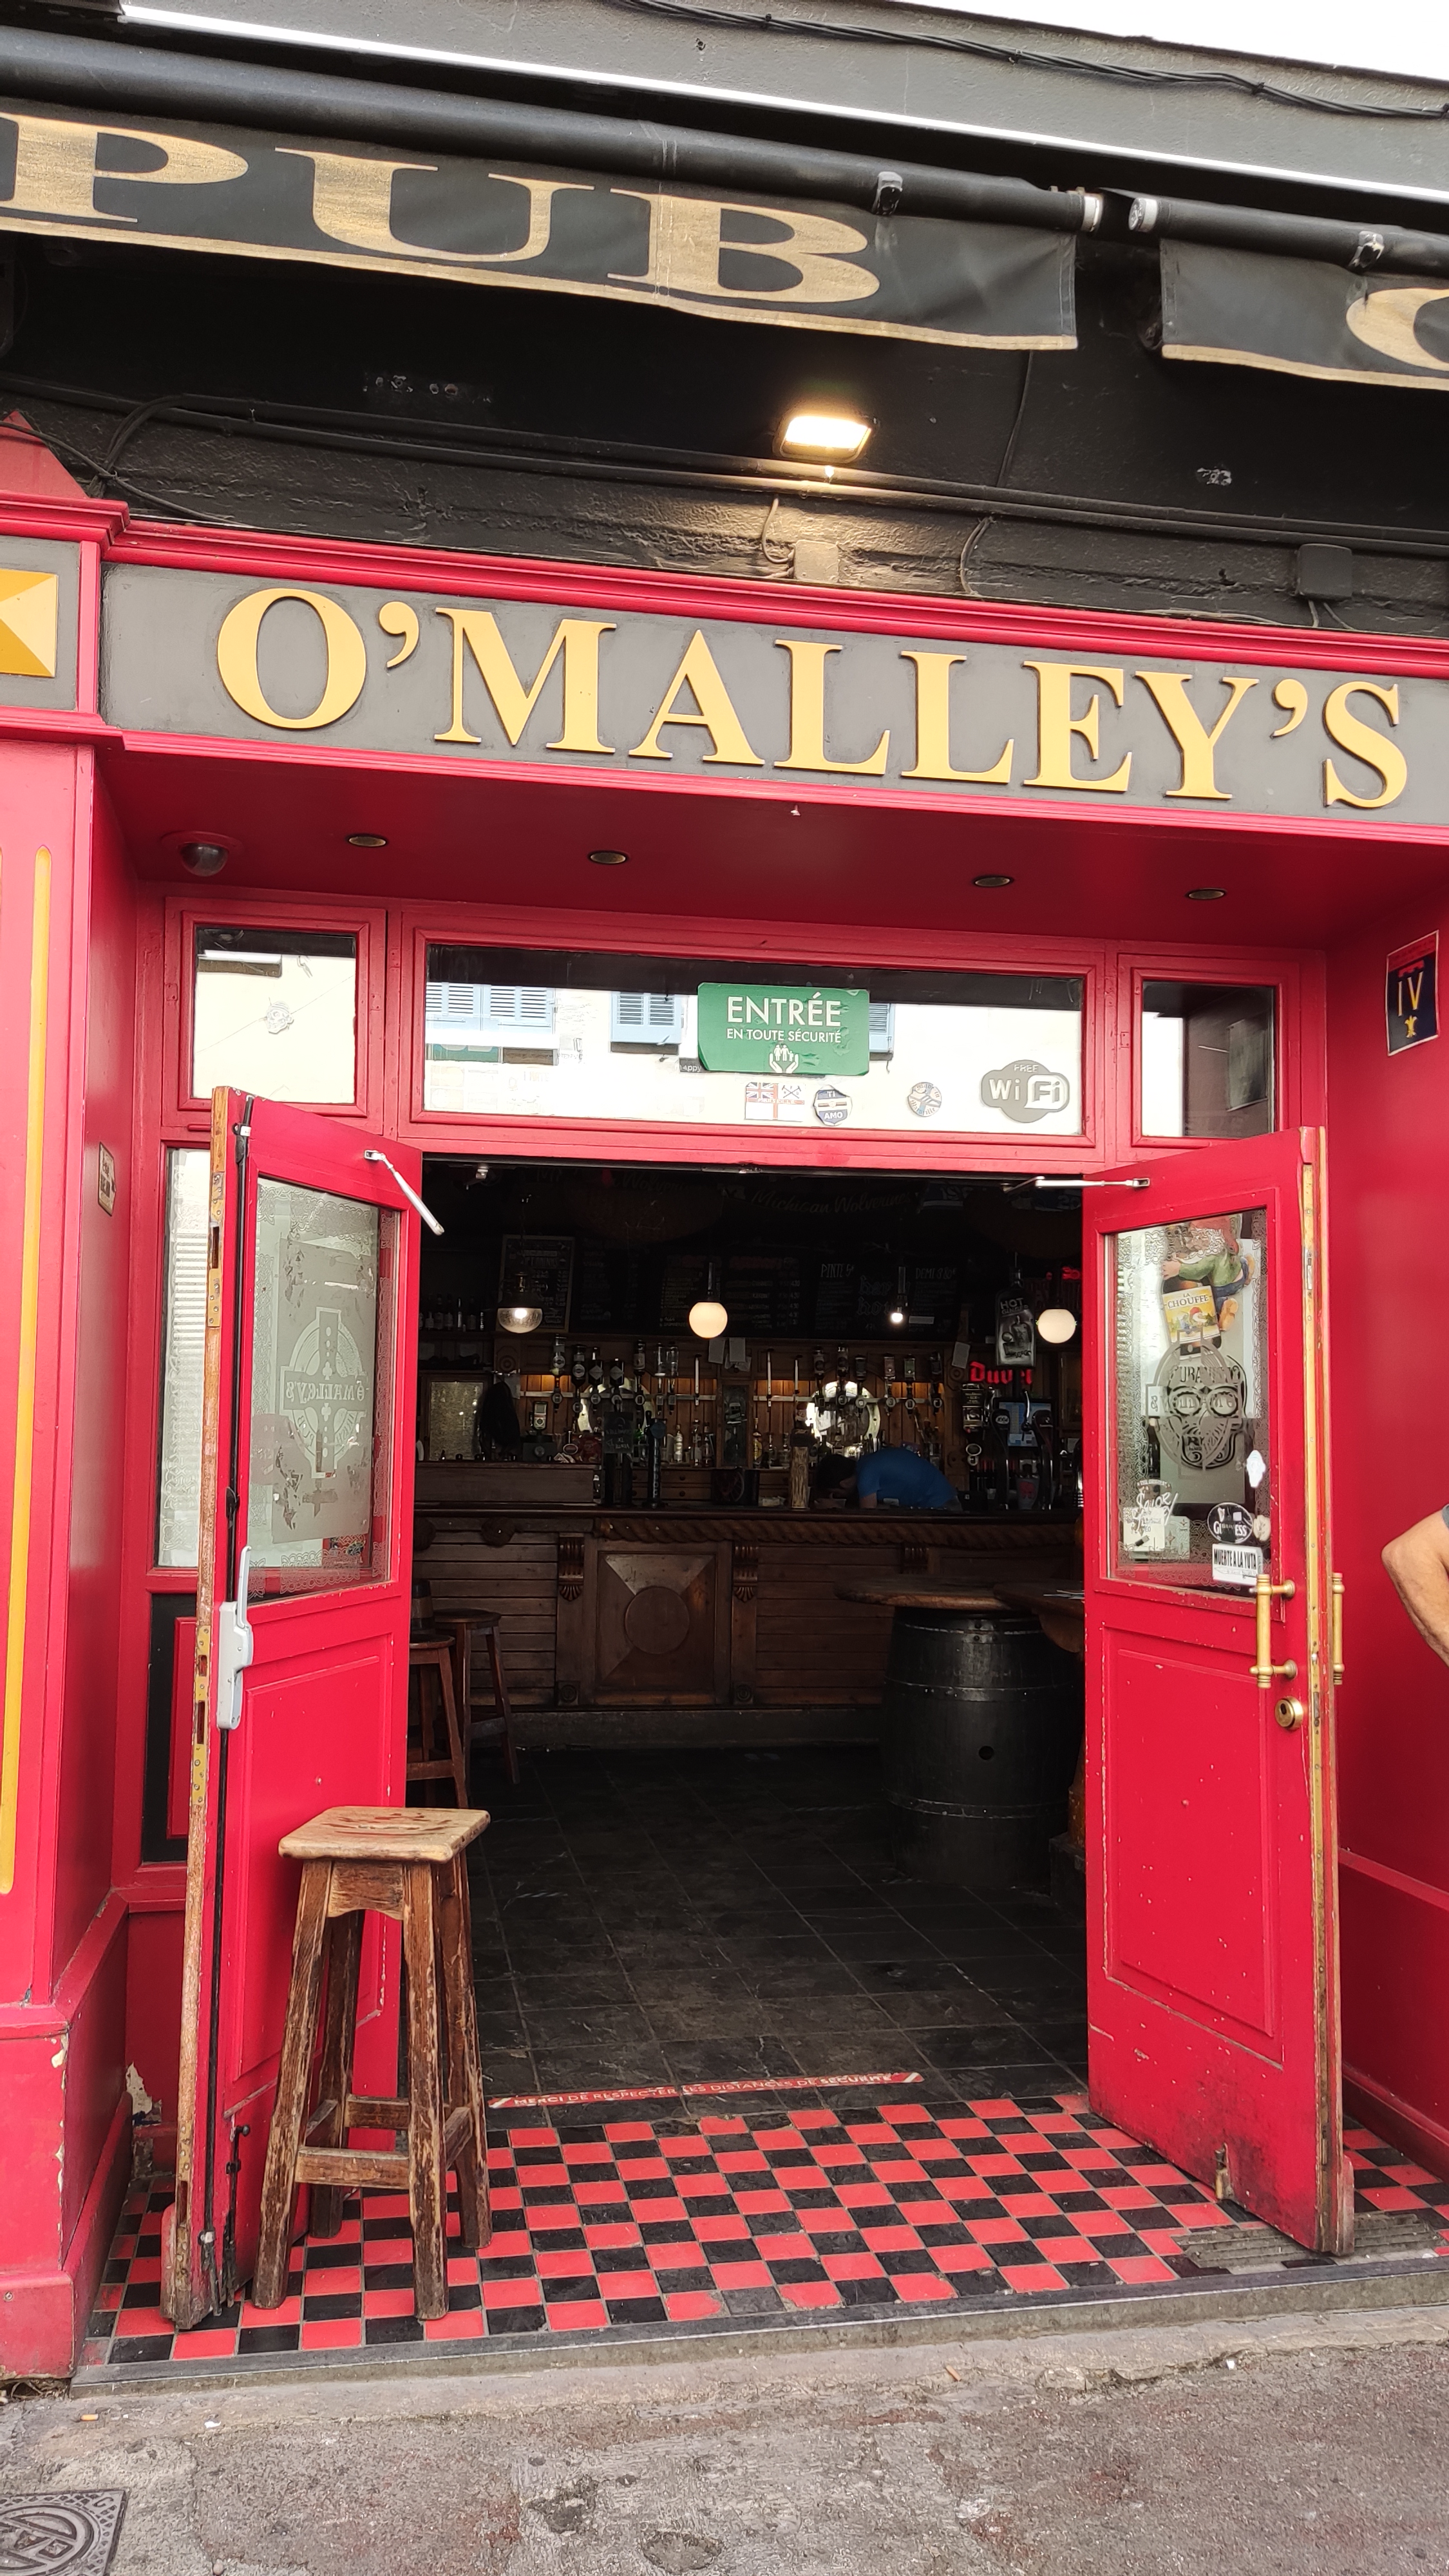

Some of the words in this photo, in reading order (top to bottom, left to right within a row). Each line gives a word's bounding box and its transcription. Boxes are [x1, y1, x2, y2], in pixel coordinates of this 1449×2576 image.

[0, 111, 881, 305] PUB
[217, 587, 1408, 810] O'MALLEY'S
[727, 991, 841, 1027] ENTRÉE
[726, 1028, 743, 1040] EN
[746, 1029, 784, 1041] TOUTE
[788, 1028, 842, 1043] SÉCURITÉ
[1014, 1064, 1039, 1073] FREE
[824, 1112, 844, 1120] AMO
[1000, 1298, 1024, 1310] HOT
[1168, 1295, 1209, 1309] CHOUFFE
[1213, 1549, 1233, 1567] MUERTE
[1233, 1550, 1237, 1567] A
[1238, 1551, 1244, 1568] LA
[1244, 1551, 1256, 1570] YUTA
[515, 2096, 564, 2107] MERCI
[568, 2094, 589, 2102] DE
[593, 2087, 677, 2100] RESPECTER
[710, 2079, 793, 2092] DISTANCES
[797, 2078, 816, 2087] DE
